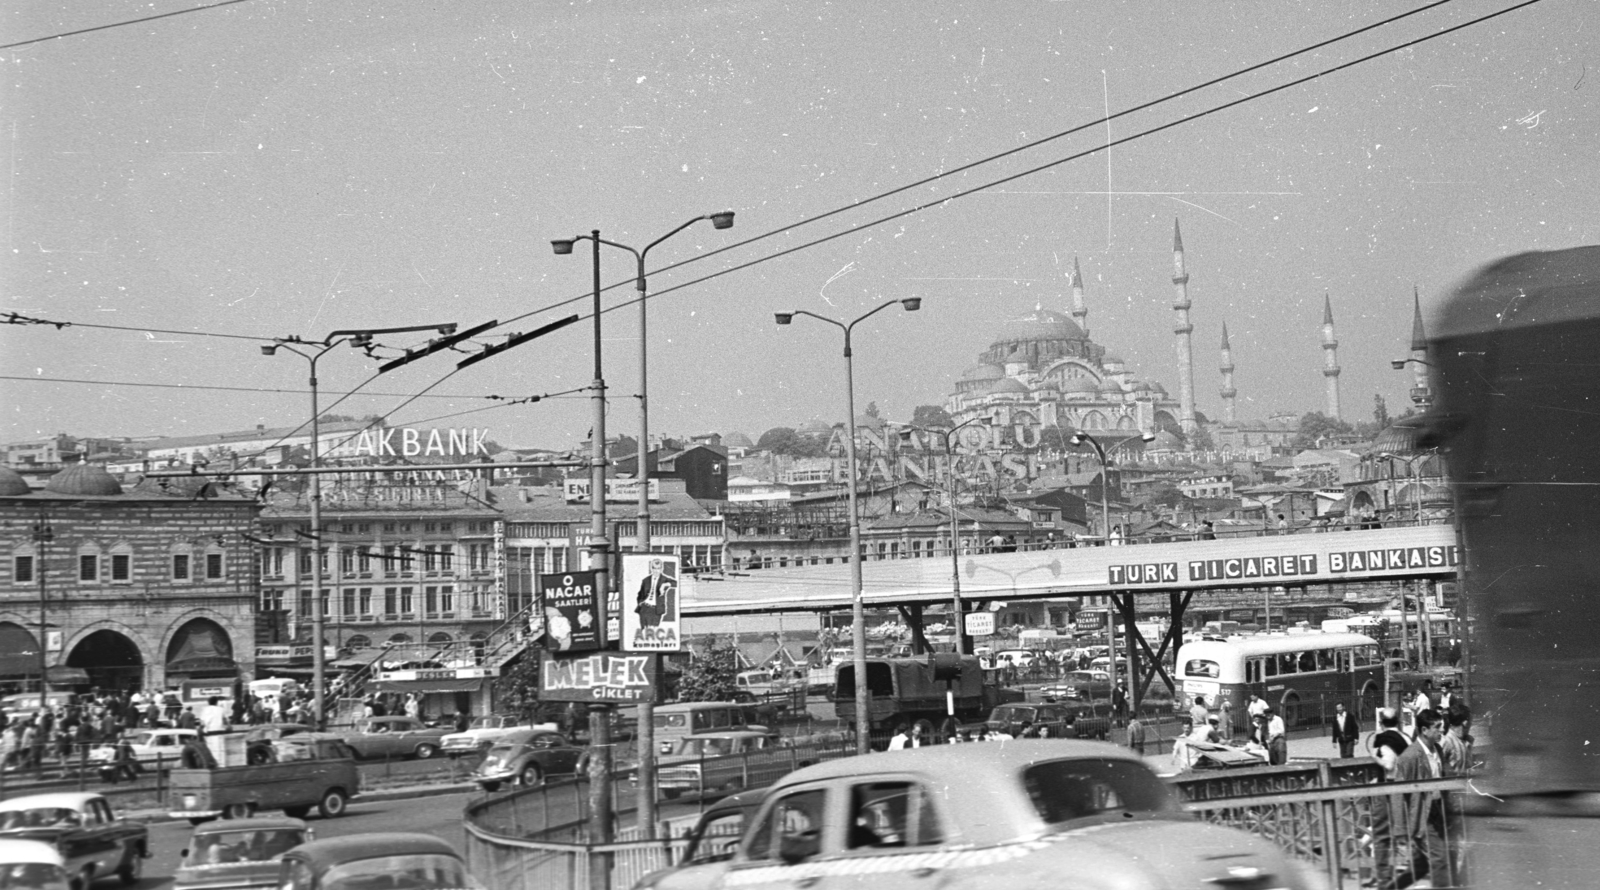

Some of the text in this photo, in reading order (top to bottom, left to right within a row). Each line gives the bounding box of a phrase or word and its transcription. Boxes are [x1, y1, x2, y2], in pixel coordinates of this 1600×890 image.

[355, 427, 489, 456] AKBANK
[825, 423, 1042, 451] ANADOLU
[831, 453, 1039, 483] BANKASI
[1110, 564, 1175, 582] TURK
[1190, 556, 1314, 579] TICARET
[545, 585, 592, 599] NACAR
[544, 655, 650, 690] MELEK
[592, 686, 643, 699] ÇİKLET
